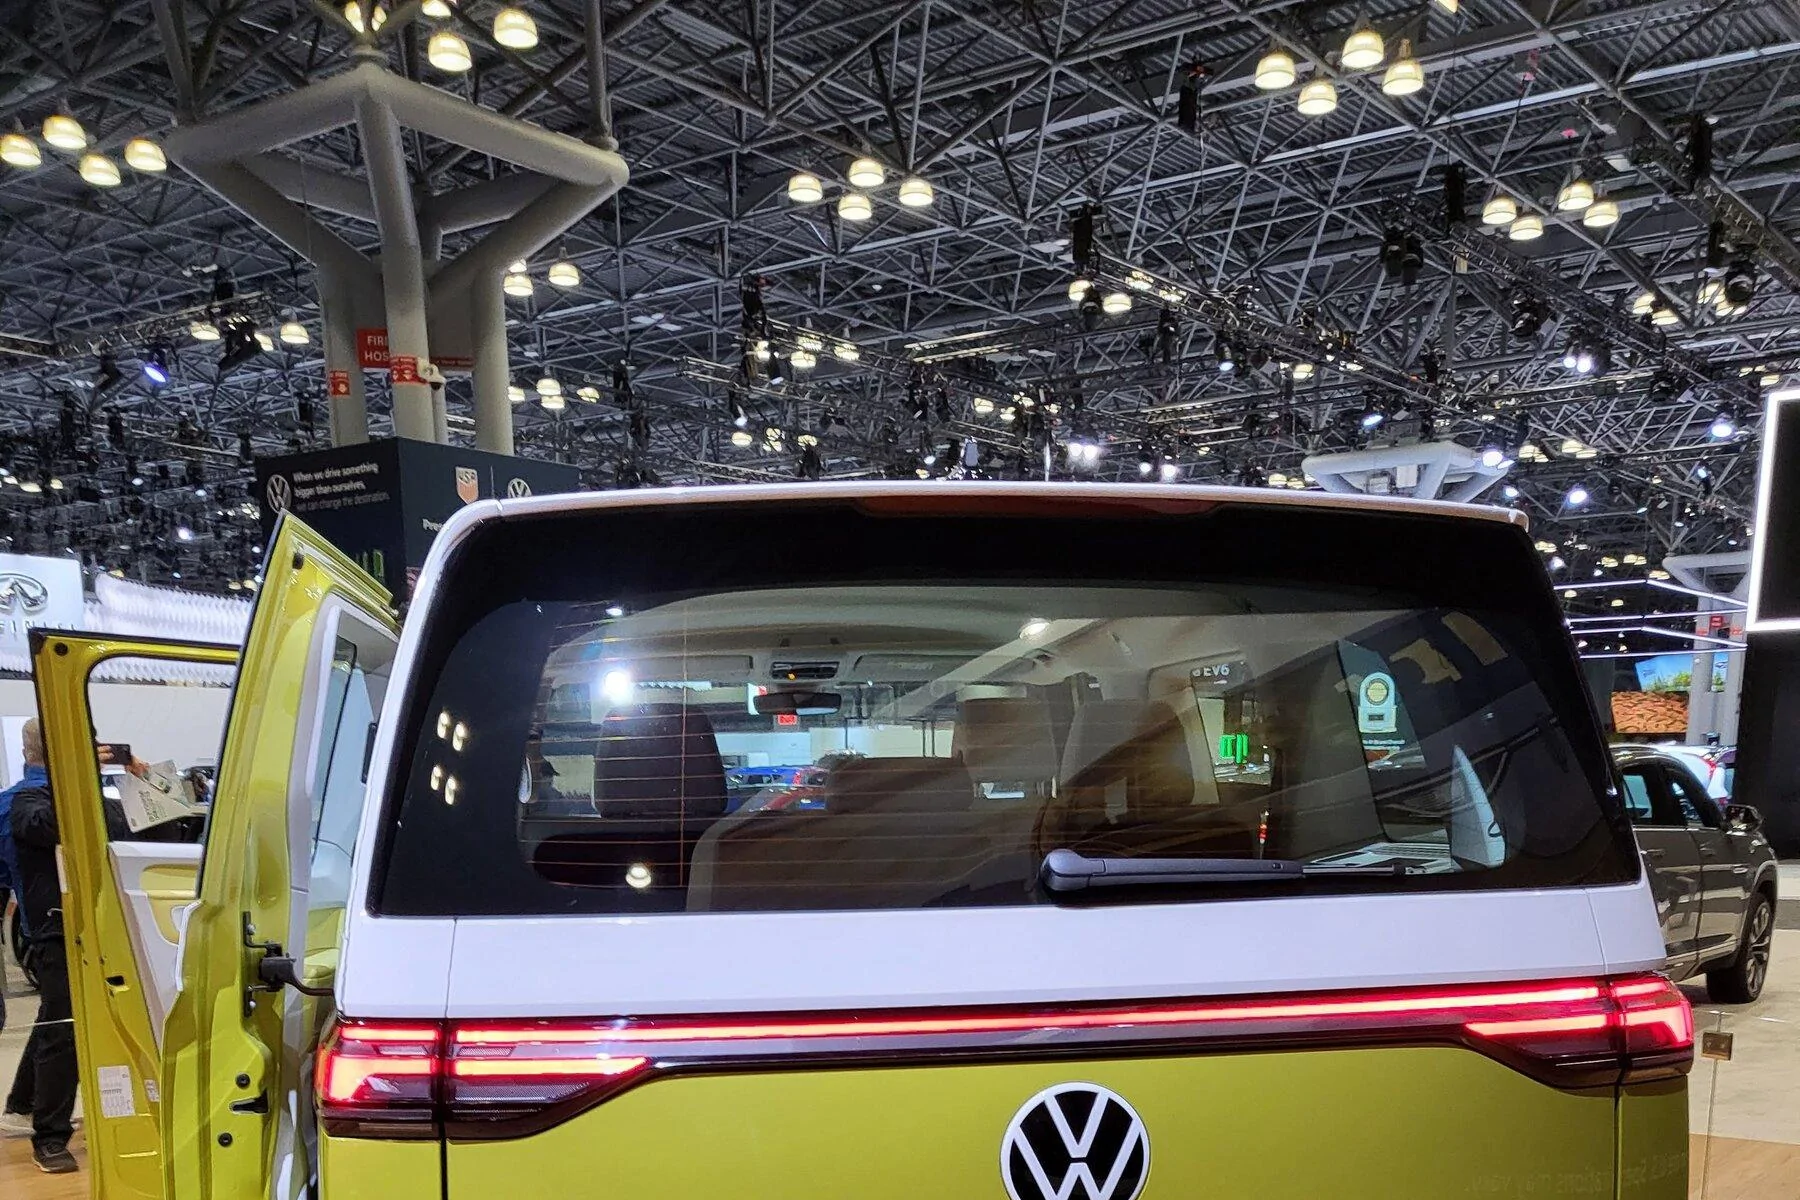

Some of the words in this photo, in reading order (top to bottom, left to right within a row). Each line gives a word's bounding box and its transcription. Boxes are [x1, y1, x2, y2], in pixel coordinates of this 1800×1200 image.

[367, 335, 388, 347] FIR
[364, 350, 389, 362] HOS
[293, 472, 313, 482] When
[341, 463, 379, 477] something
[1203, 664, 1230, 677] EV6
